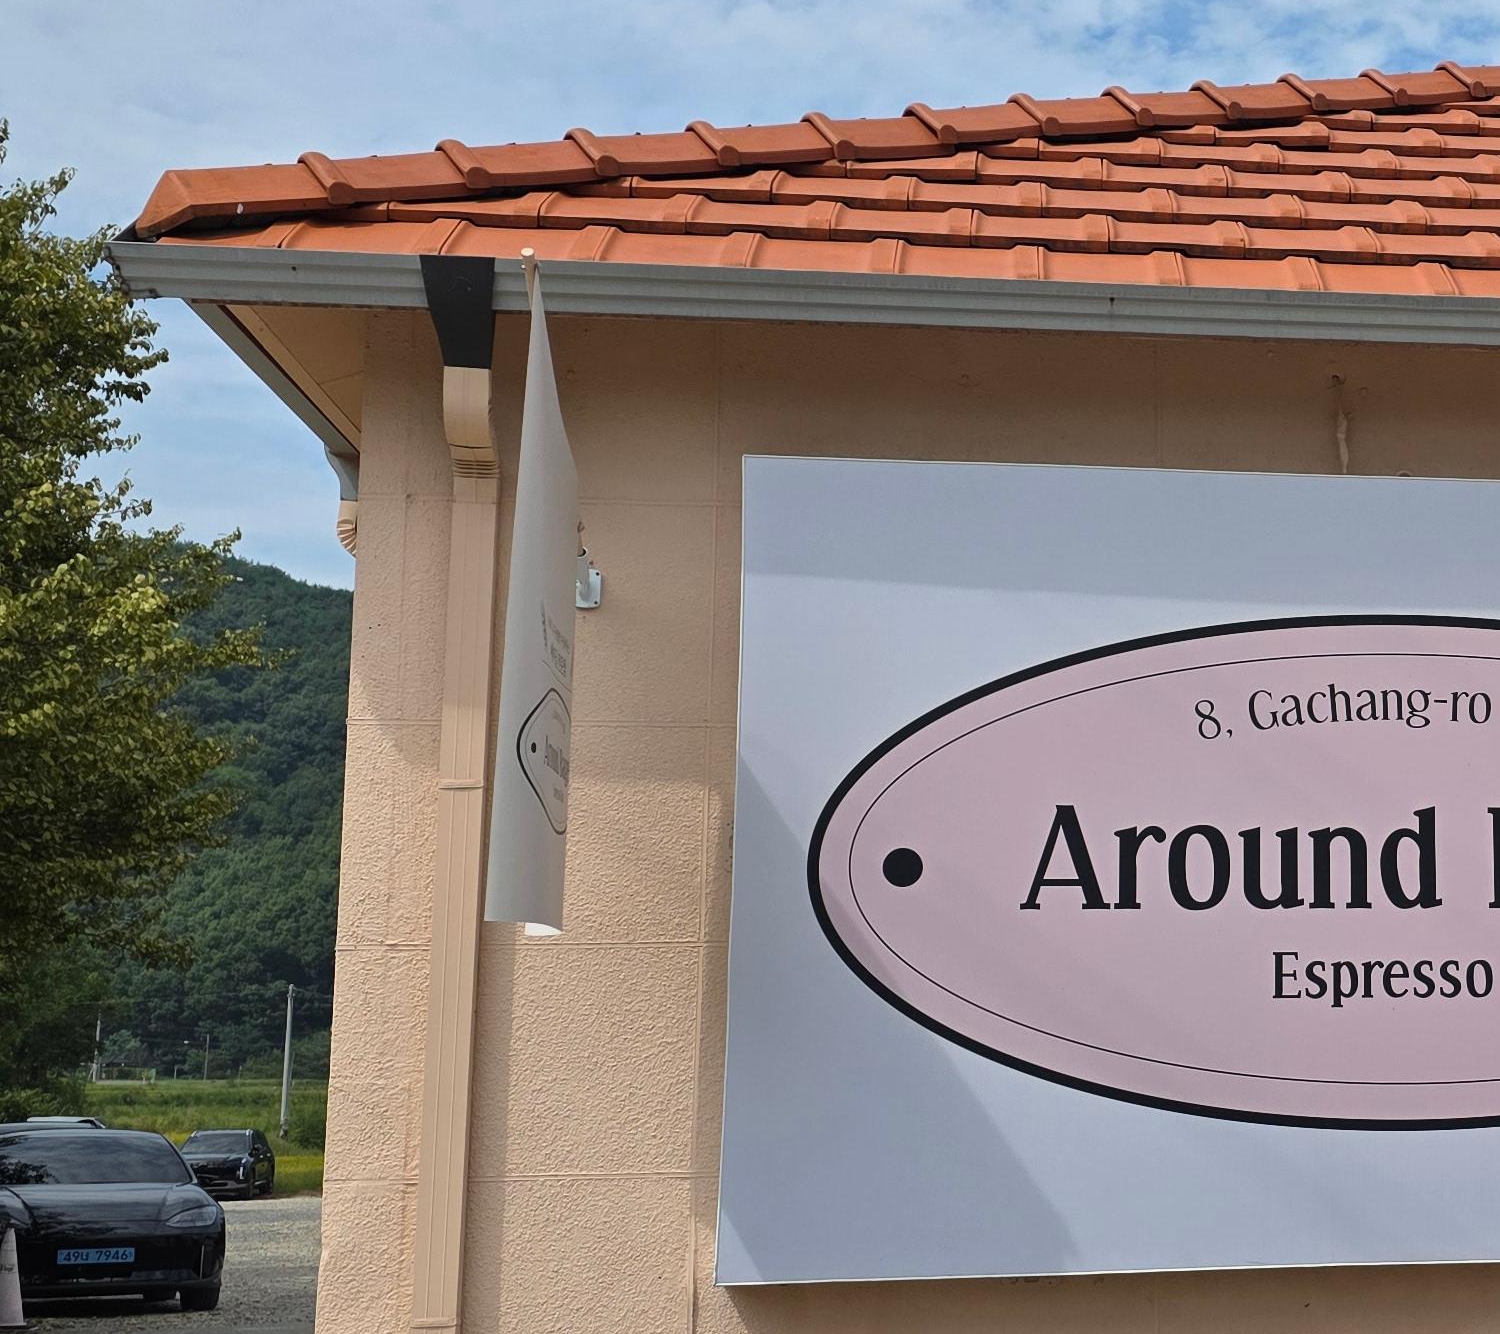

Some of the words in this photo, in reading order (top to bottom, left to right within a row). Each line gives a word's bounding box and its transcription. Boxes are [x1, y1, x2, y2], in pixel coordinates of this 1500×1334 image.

[1194, 699, 1233, 740] 8,
[1248, 683, 1492, 731] Gachang-ro
[1019, 804, 1443, 911] Around
[1272, 951, 1494, 1008] Espresso
[96, 1249, 128, 1262] 7946
